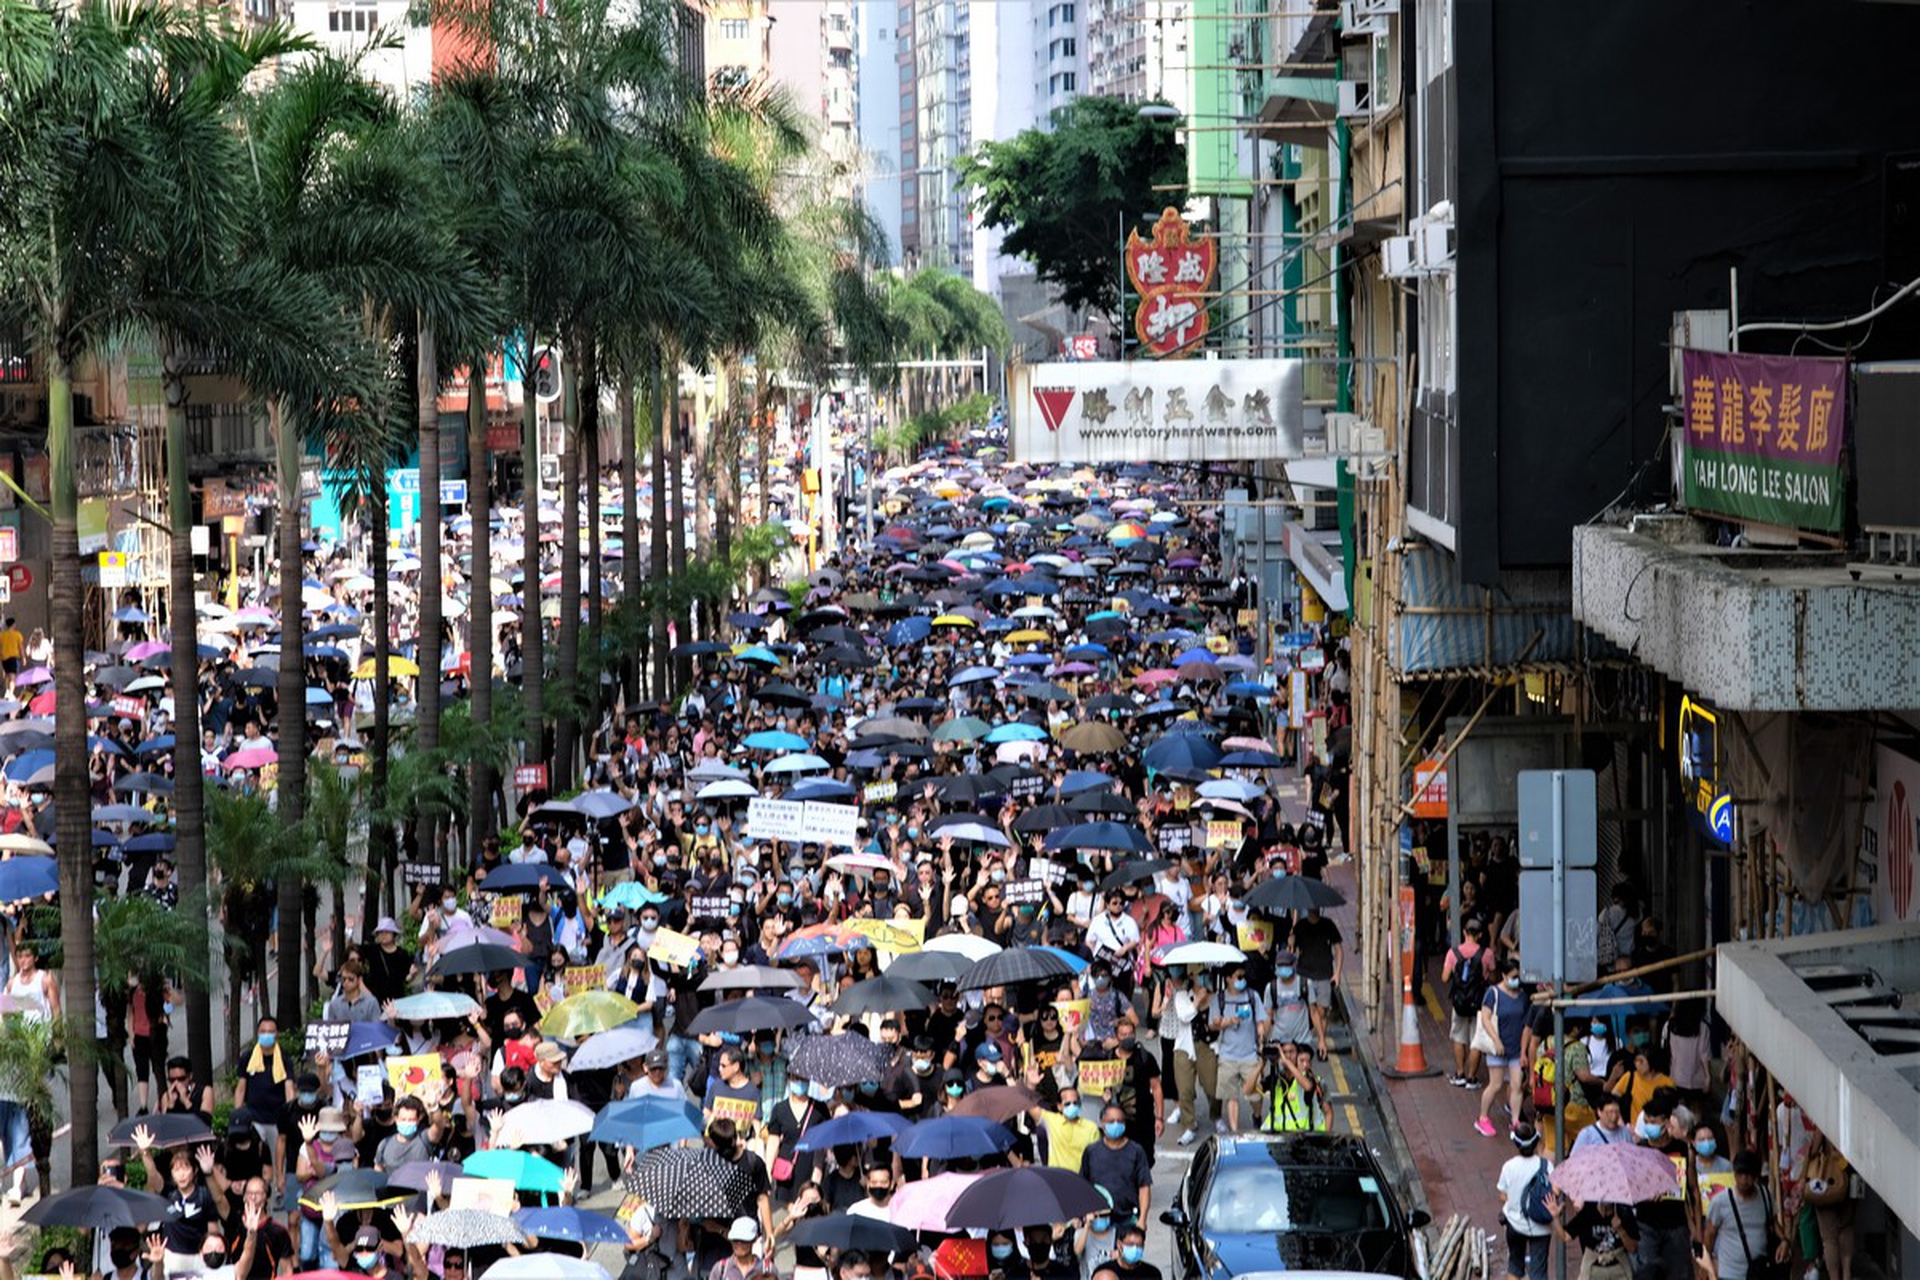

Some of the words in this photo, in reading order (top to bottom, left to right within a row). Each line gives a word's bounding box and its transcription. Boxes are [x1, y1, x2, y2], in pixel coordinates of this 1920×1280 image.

[1079, 425, 1278, 440] www.victoryhardware.com
[1691, 375, 1835, 454] 華龍李髮廊
[1721, 462, 1758, 495] LONG
[1762, 467, 1782, 500] LEE
[1785, 472, 1830, 507] SALON
